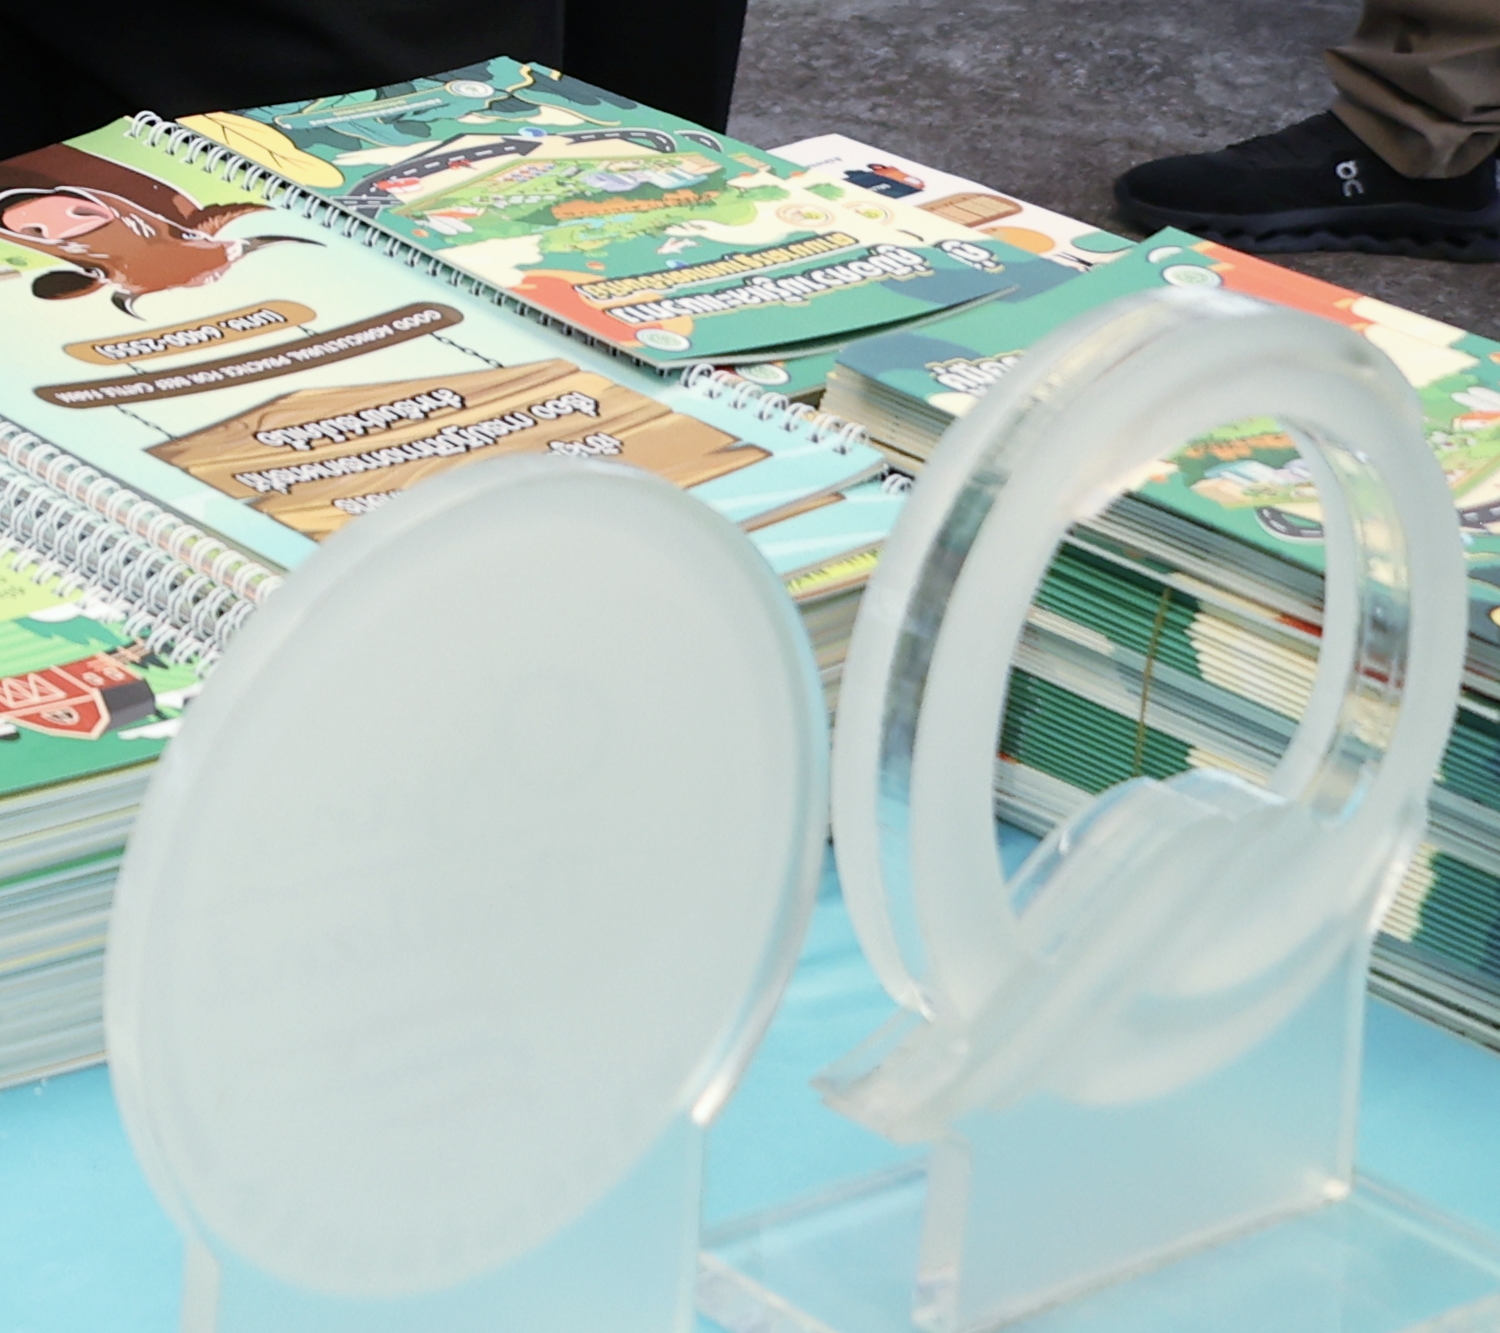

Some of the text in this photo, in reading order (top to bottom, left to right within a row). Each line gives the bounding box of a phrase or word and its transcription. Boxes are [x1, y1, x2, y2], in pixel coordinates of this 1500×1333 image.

[54, 307, 441, 404] GOOD AGRICULTURAL PRACTICE FOR BEEF CATTLE FARM
[93, 322, 222, 362] 6400-2555)
